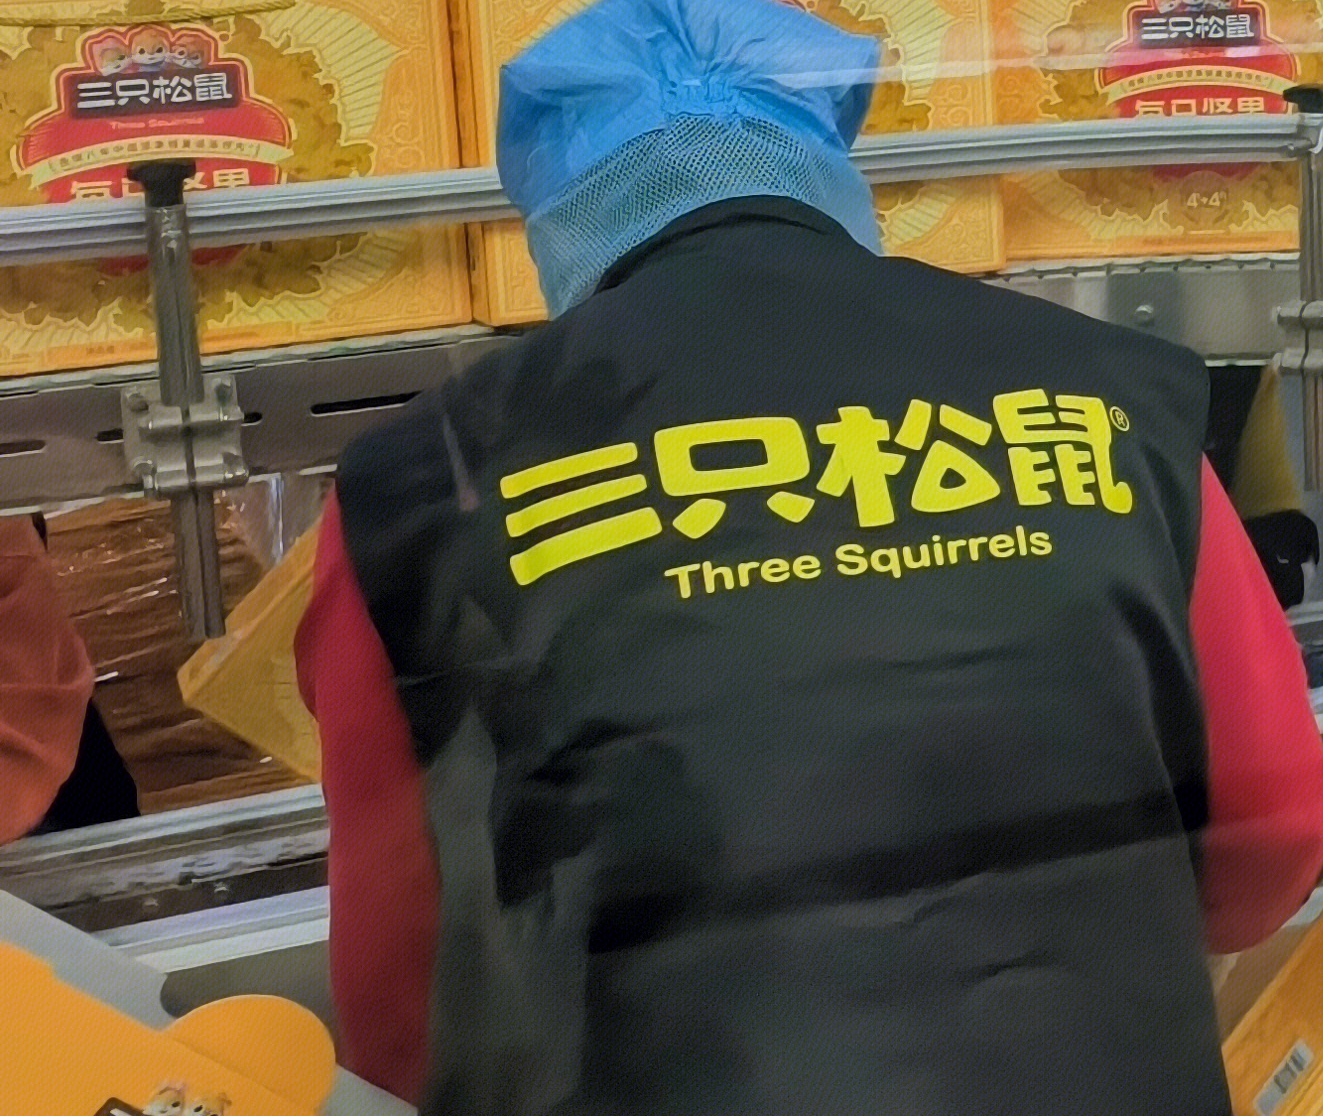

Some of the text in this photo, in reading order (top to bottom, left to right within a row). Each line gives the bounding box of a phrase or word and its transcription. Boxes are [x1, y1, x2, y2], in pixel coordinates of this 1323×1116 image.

[1140, 13, 1255, 41] 三只松鼠
[75, 72, 233, 109] 三只松鼠
[499, 388, 1133, 587] 三只松鼠
[664, 524, 1054, 598] Three Squirrels
